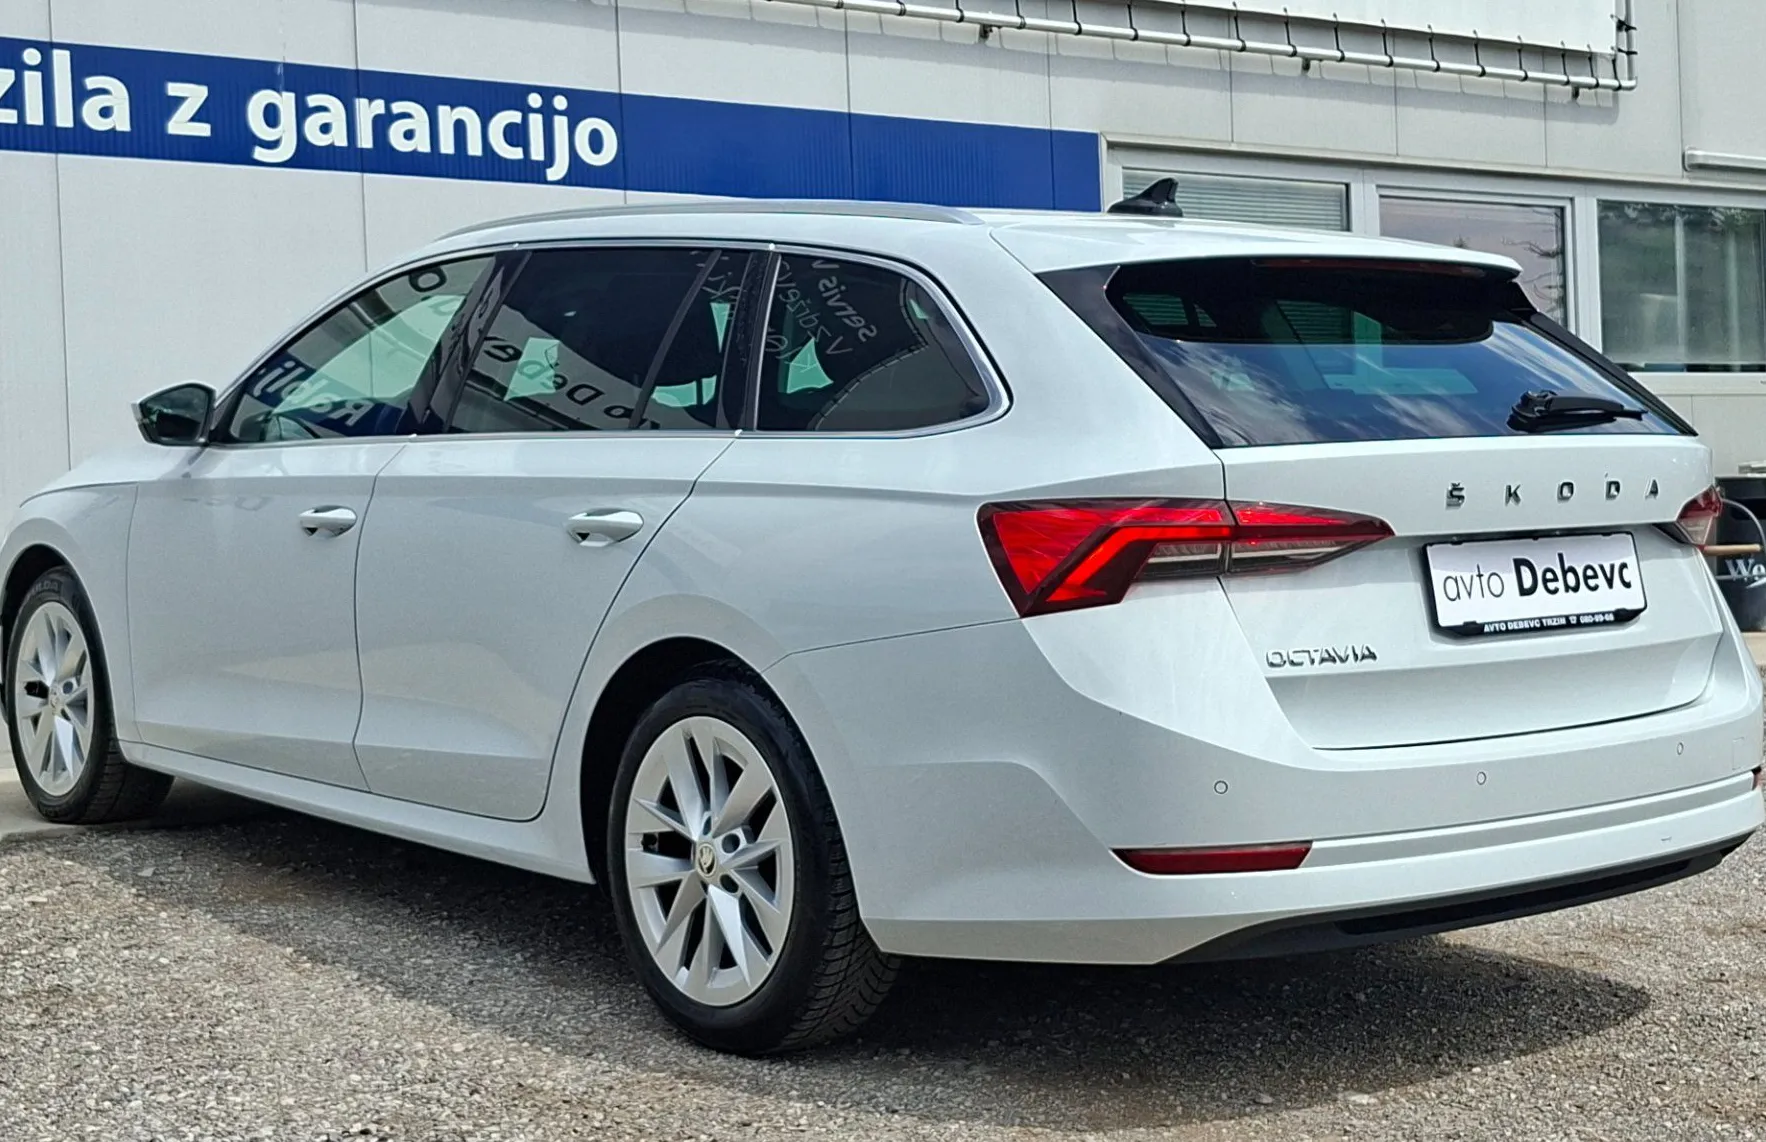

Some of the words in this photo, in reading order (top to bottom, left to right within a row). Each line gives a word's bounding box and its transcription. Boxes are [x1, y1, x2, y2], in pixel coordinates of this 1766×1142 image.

[166, 81, 212, 137] z
[246, 87, 619, 181] garancijo
[1446, 479, 1660, 508] ŠKODA
[1443, 563, 1505, 601] avto
[1512, 552, 1632, 597] Debevc
[1483, 621, 1507, 633] AVTO
[1507, 619, 1541, 631] DEBEVC
[1541, 616, 1567, 627] TRZIN
[1265, 644, 1378, 668] OCTAVIA
